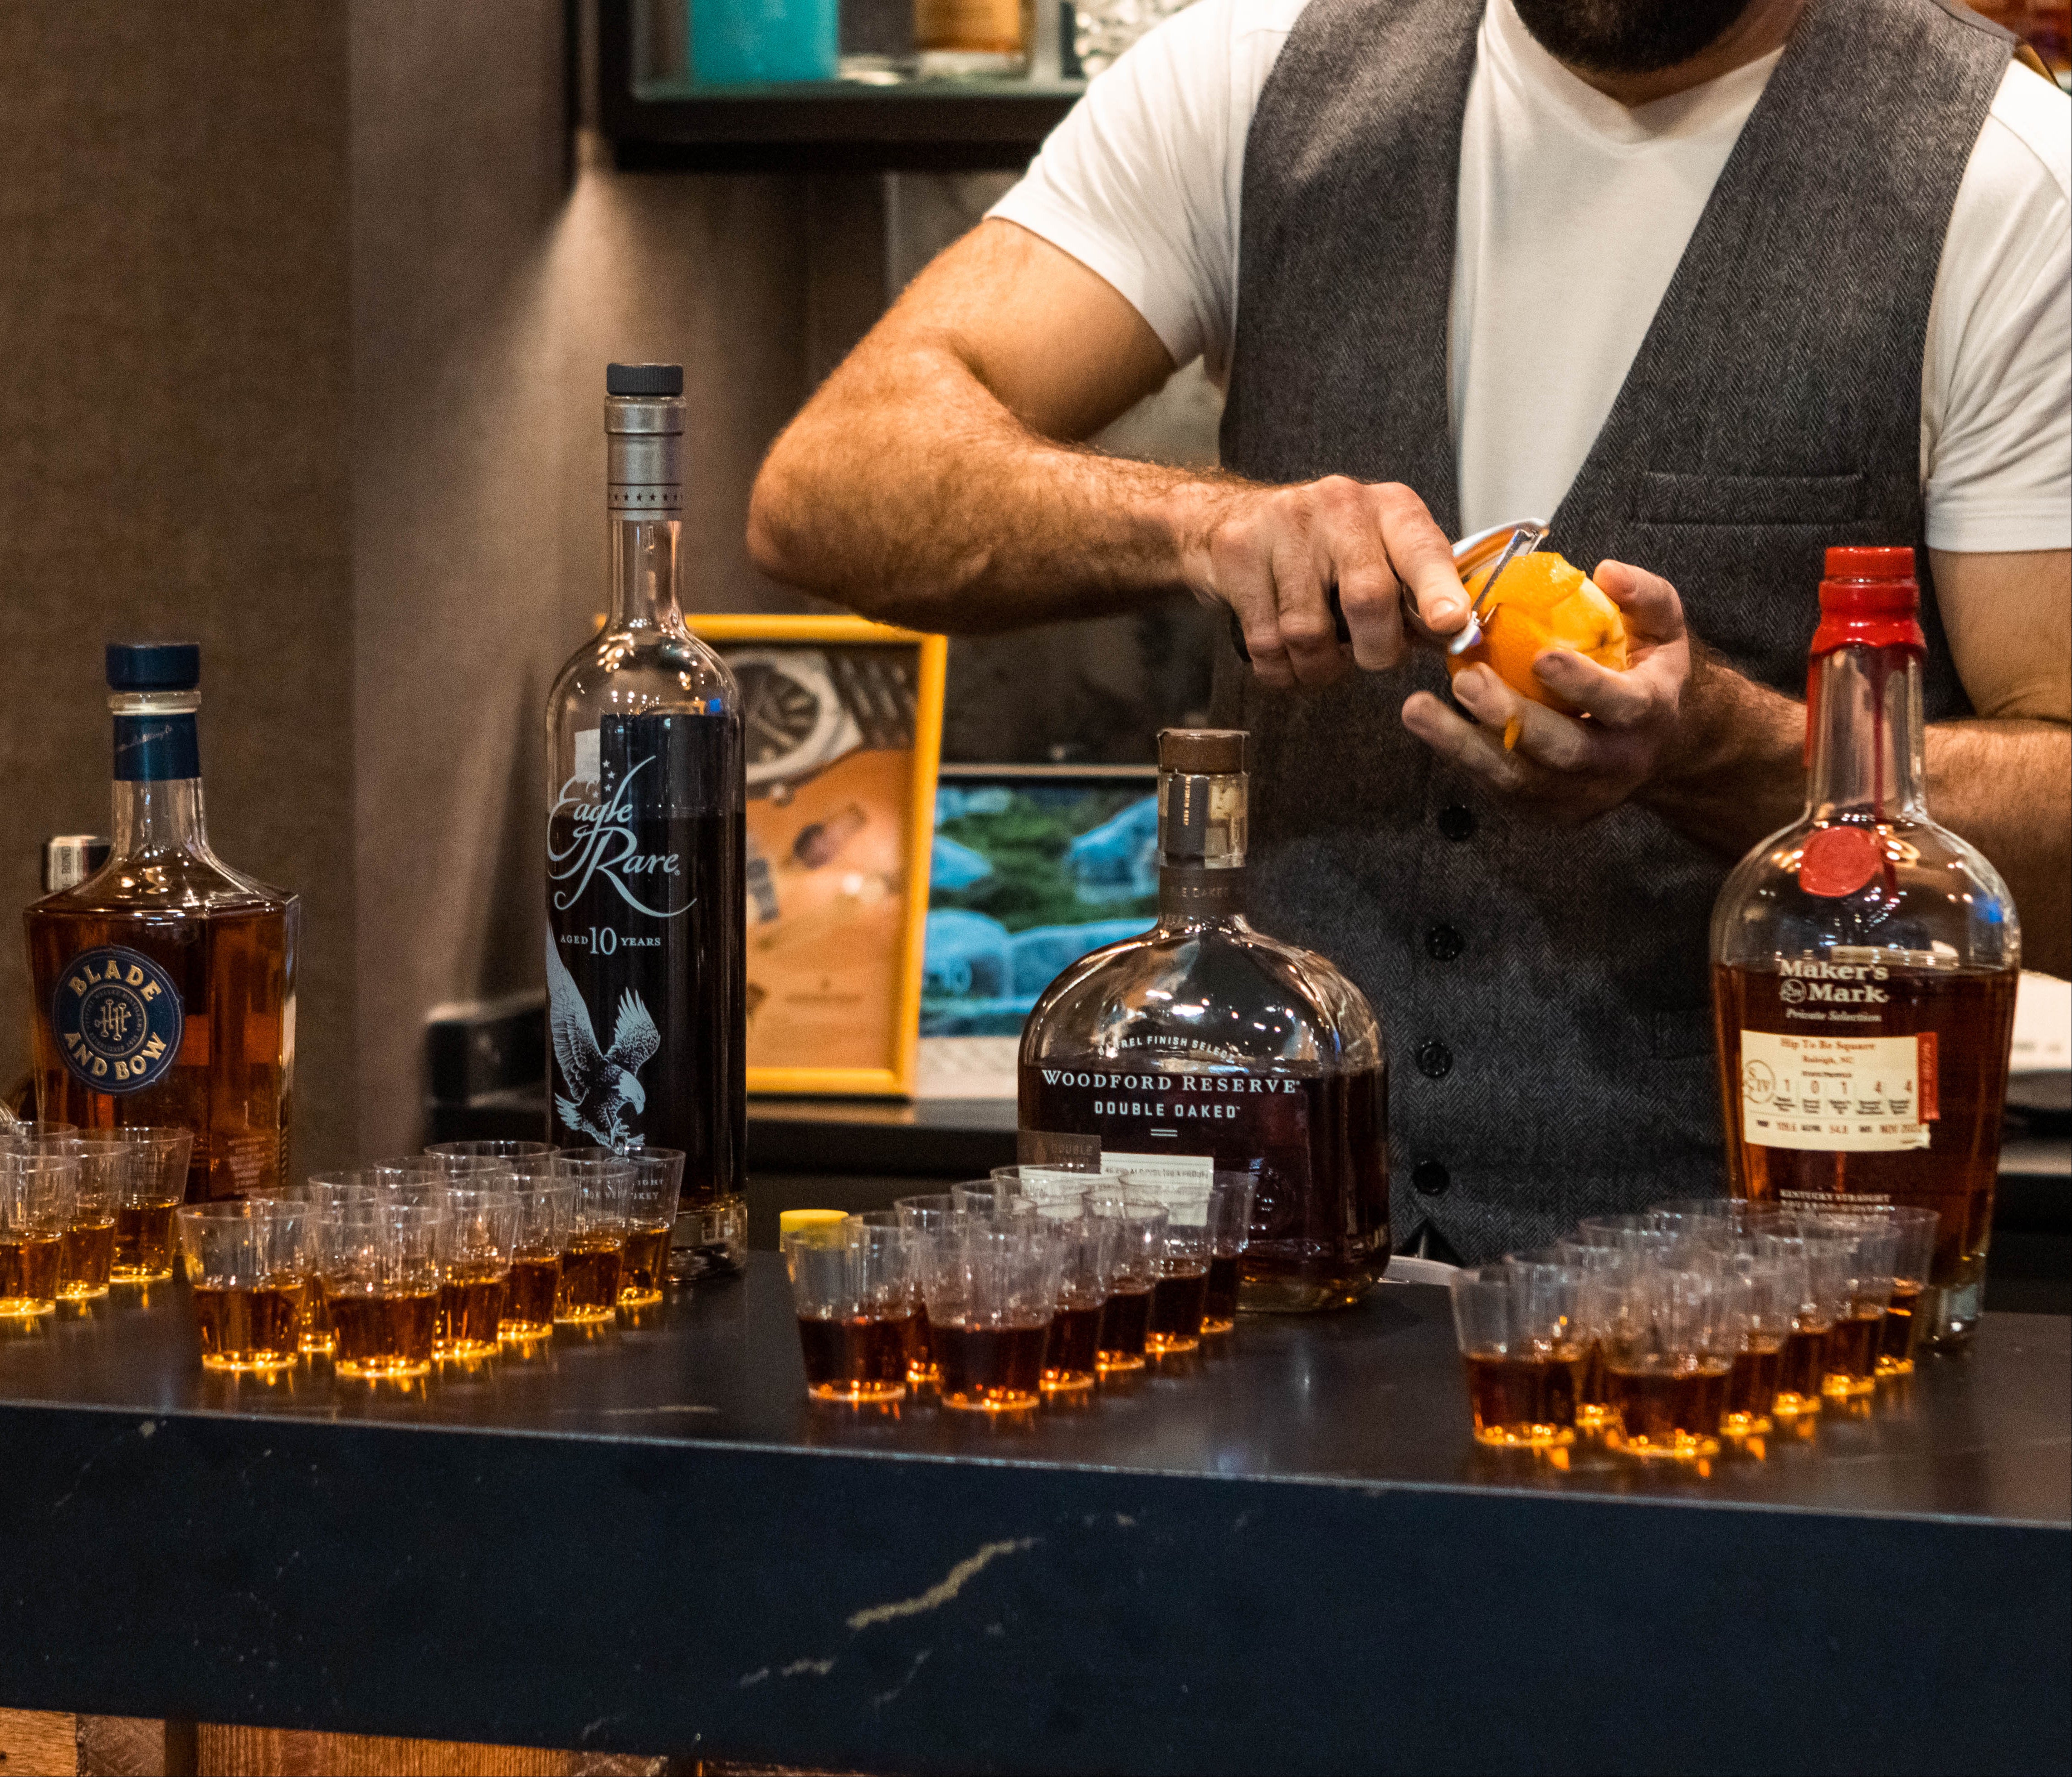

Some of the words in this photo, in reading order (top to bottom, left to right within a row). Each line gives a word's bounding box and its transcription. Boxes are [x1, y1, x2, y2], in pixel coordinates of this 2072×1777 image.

[547, 755, 657, 879] Eagle
[554, 824, 697, 918] Rare
[561, 934, 589, 944] AGED
[589, 927, 617, 955] 10
[620, 937, 661, 947] YEARS
[68, 960, 162, 1001] BLADE
[1779, 959, 1889, 981] Maker's
[1808, 982, 1887, 1003] Mark
[1147, 1035, 1188, 1047] FINISH
[63, 1032, 108, 1077] AND
[114, 1032, 167, 1080] BOW
[1042, 1069, 1172, 1090] WOODFORD
[1182, 1075, 1297, 1094] RESERVE
[1811, 1080, 1820, 1094] 0
[1874, 1080, 1882, 1094] 4
[1904, 1080, 1912, 1093] 4
[1094, 1101, 1165, 1117] DOUBLE
[1175, 1104, 1236, 1118] OAKED
